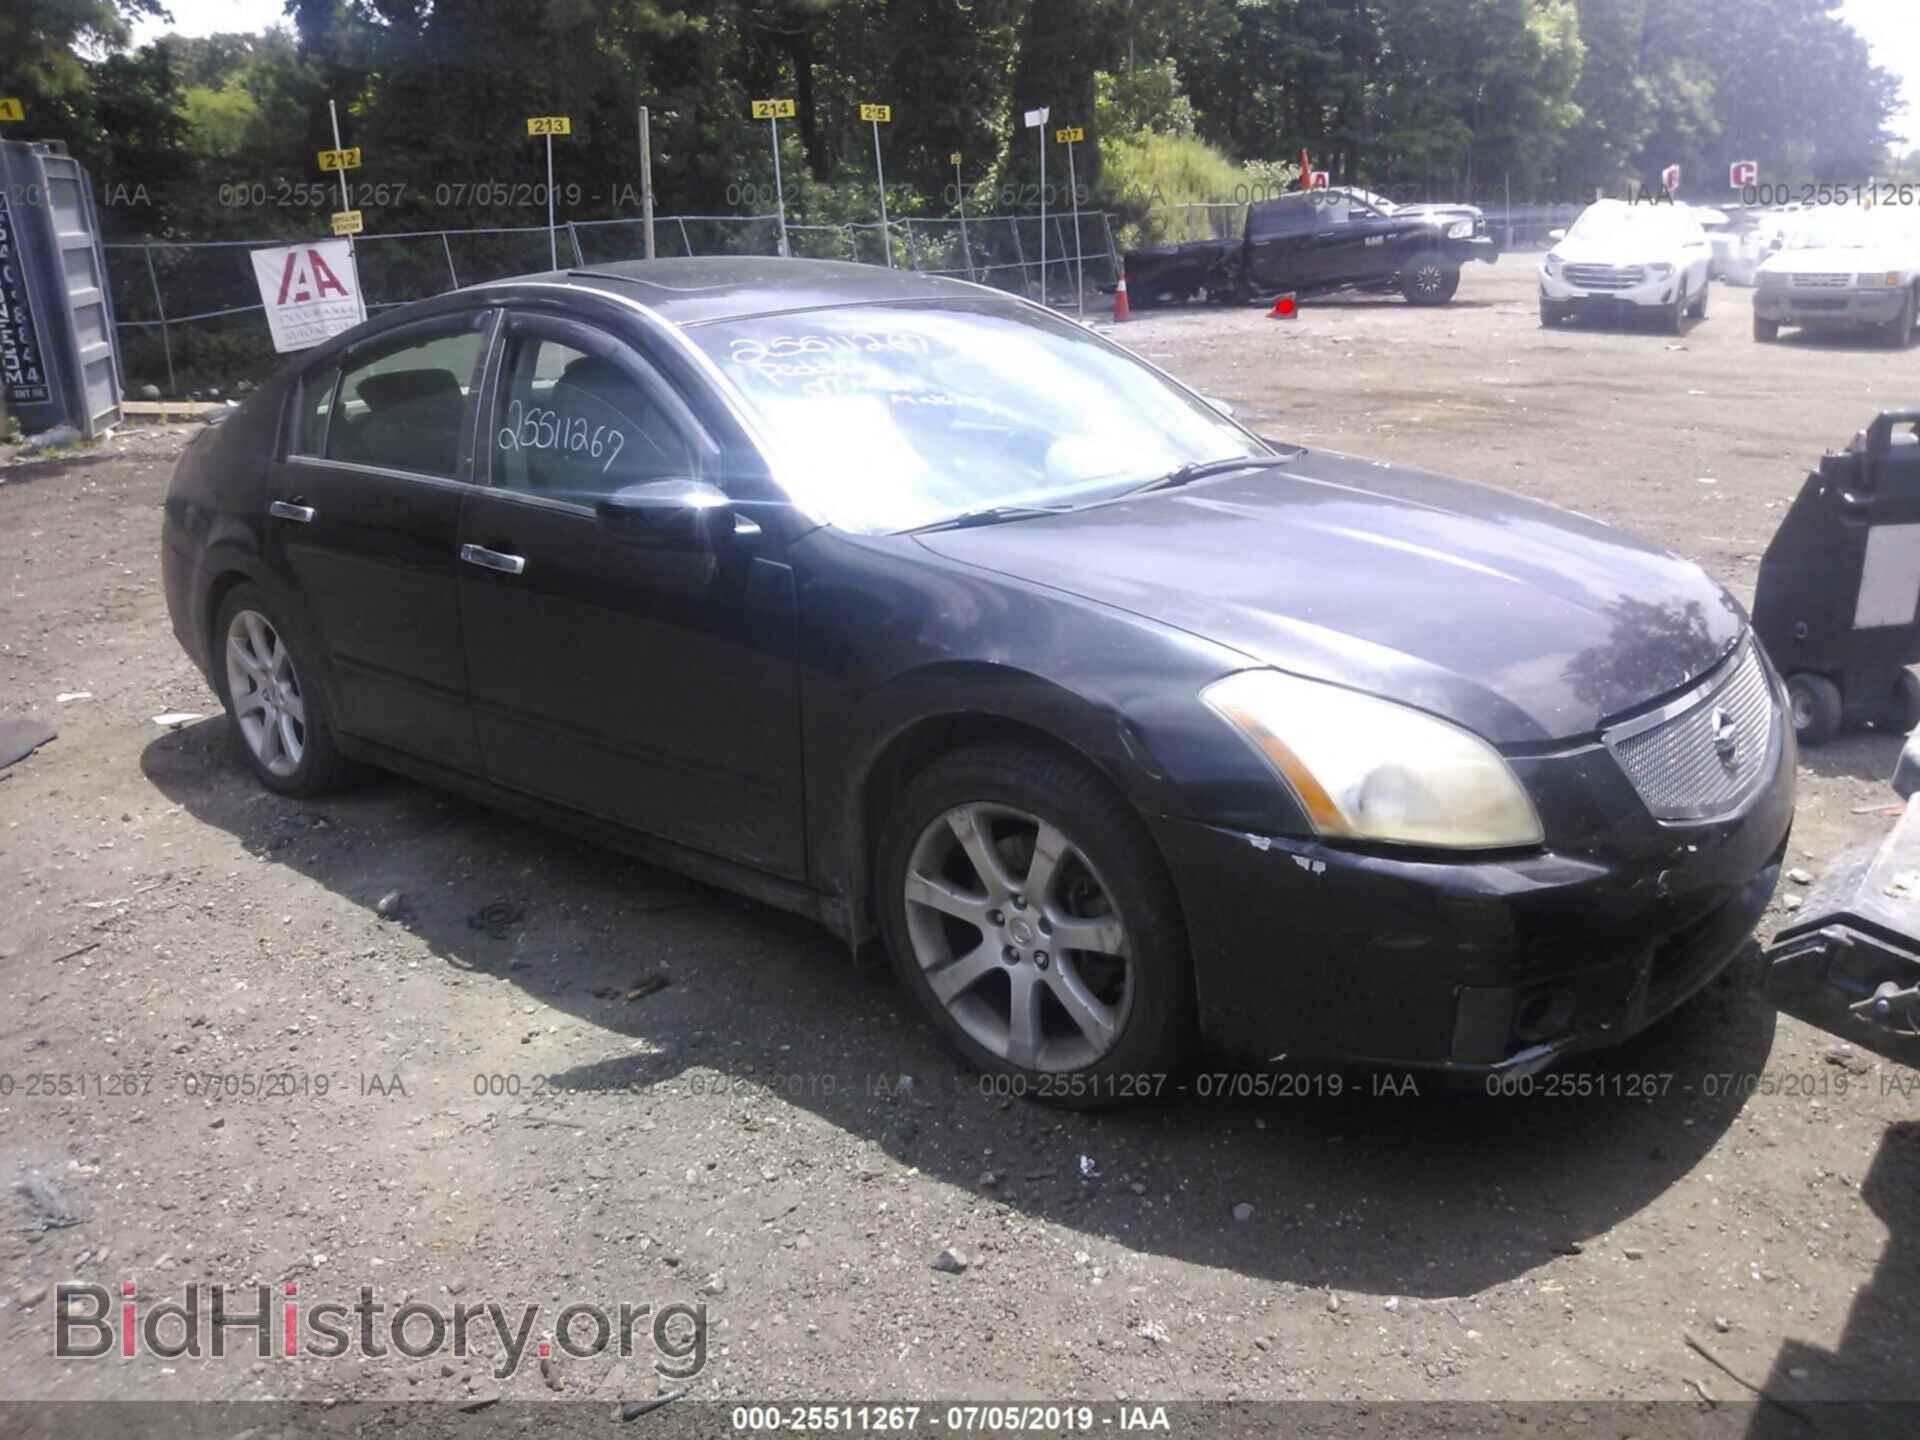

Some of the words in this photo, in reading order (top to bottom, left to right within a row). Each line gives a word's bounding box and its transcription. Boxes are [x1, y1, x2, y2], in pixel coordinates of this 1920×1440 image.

[759, 102, 788, 117] 214
[534, 119, 564, 132] 213
[1060, 130, 1079, 141] 217
[326, 152, 356, 168] 212
[1314, 173, 1328, 188] A
[1733, 163, 1755, 186] C
[498, 399, 624, 473] 25511267
